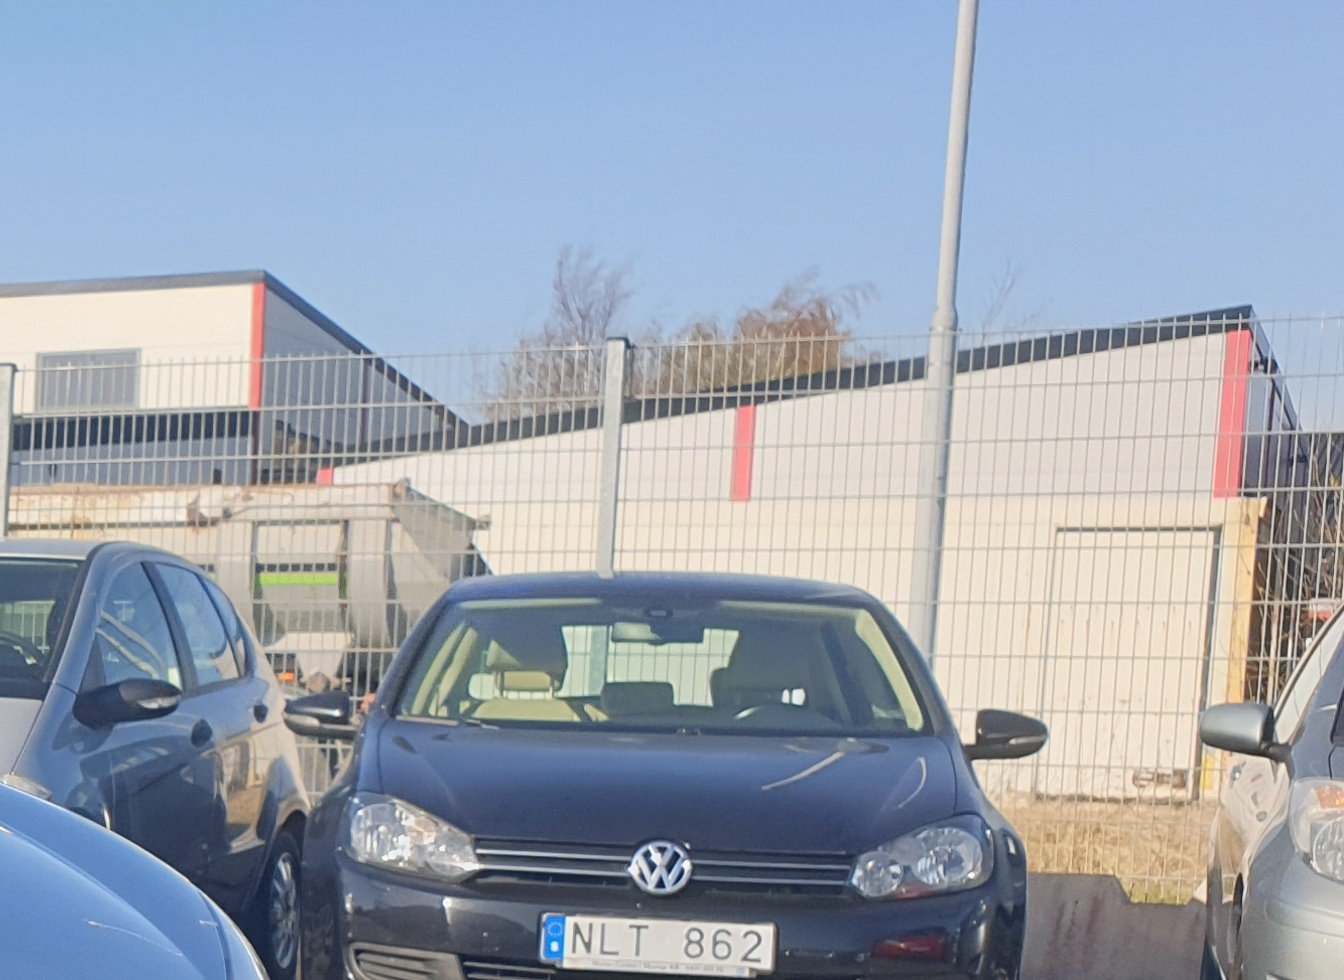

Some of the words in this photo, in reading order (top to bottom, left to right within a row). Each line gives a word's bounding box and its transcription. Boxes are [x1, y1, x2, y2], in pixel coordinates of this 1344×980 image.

[630, 841, 692, 894] VW
[571, 922, 649, 957] NLT
[683, 927, 763, 963] 862
